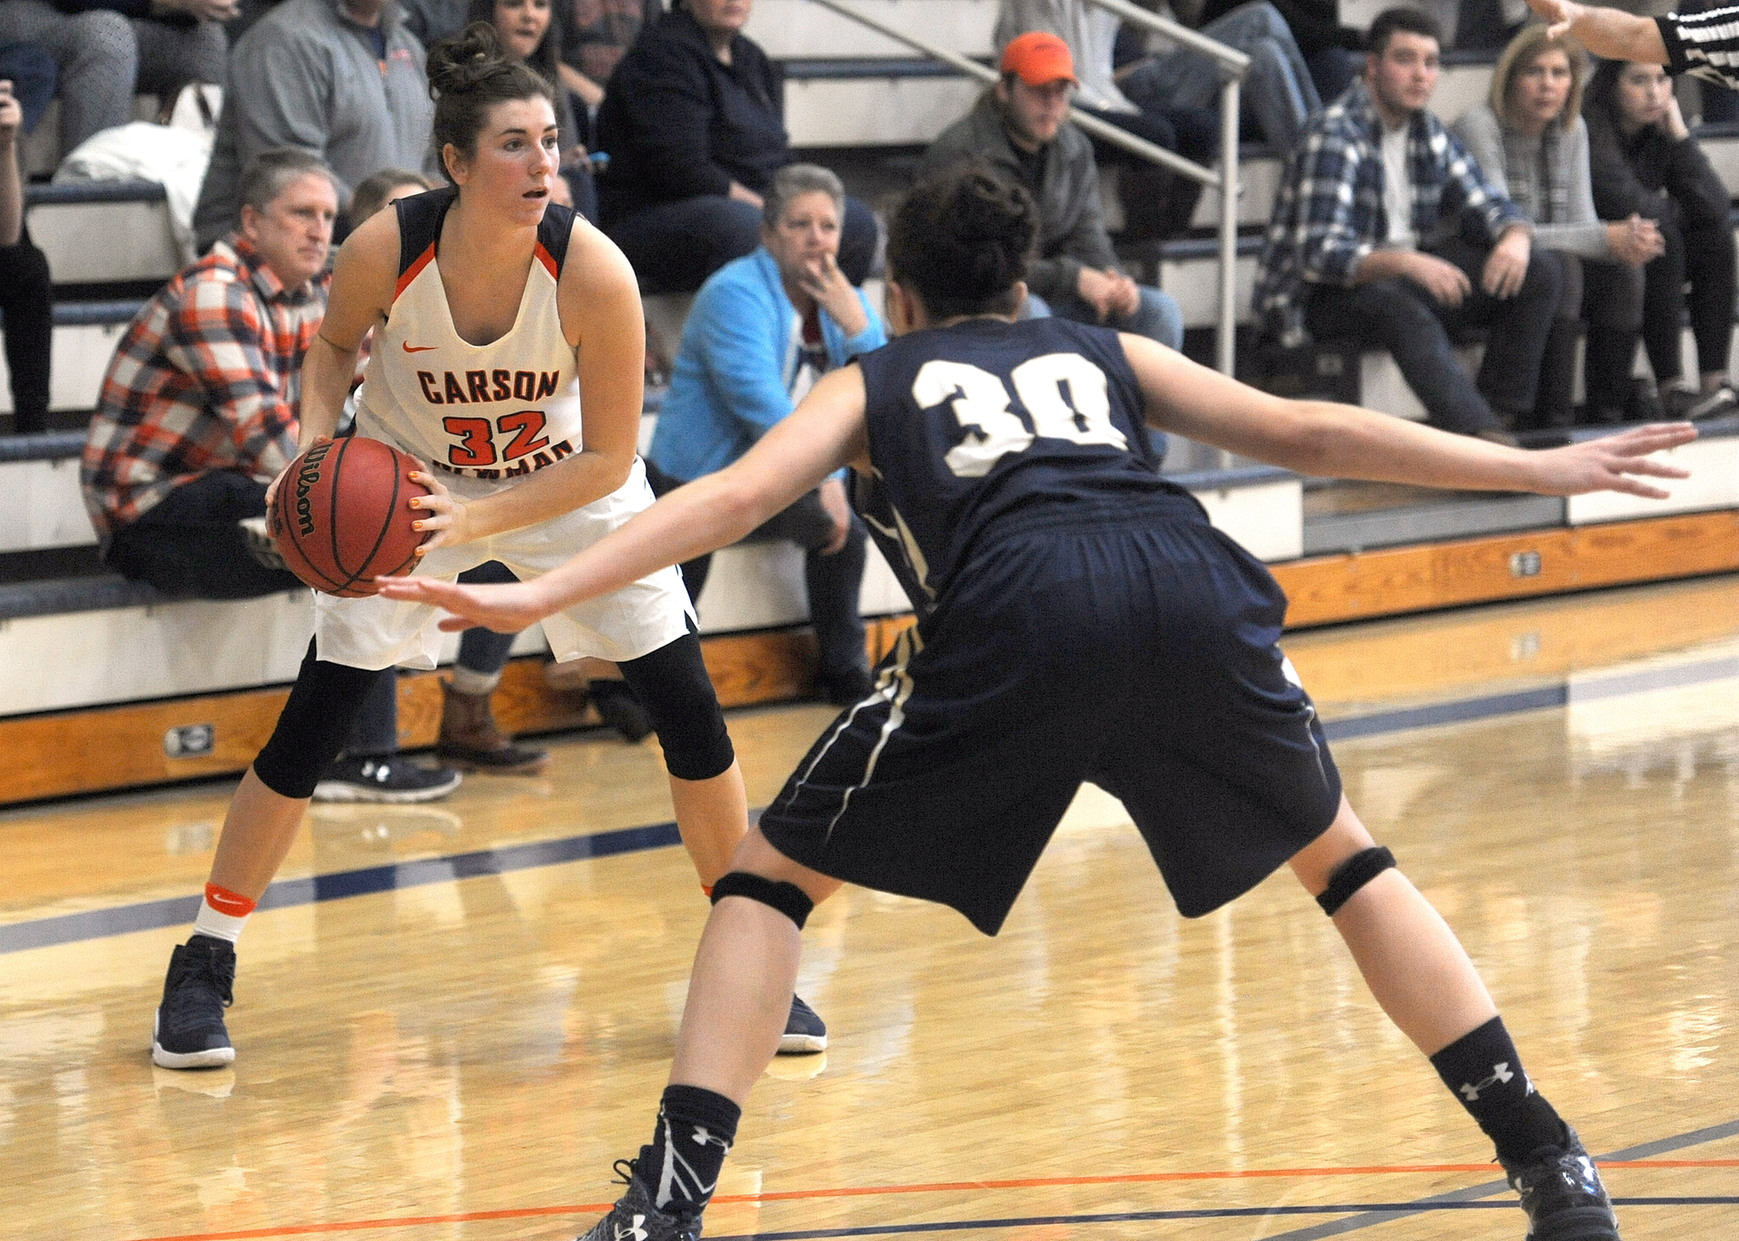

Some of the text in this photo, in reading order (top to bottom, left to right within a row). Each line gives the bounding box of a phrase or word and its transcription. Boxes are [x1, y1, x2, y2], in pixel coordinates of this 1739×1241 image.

[416, 368, 560, 405] CARSON
[441, 410, 551, 466] 32
[911, 353, 1129, 477] 30
[431, 439, 574, 480] WMAN
[296, 442, 335, 539] Wilson
